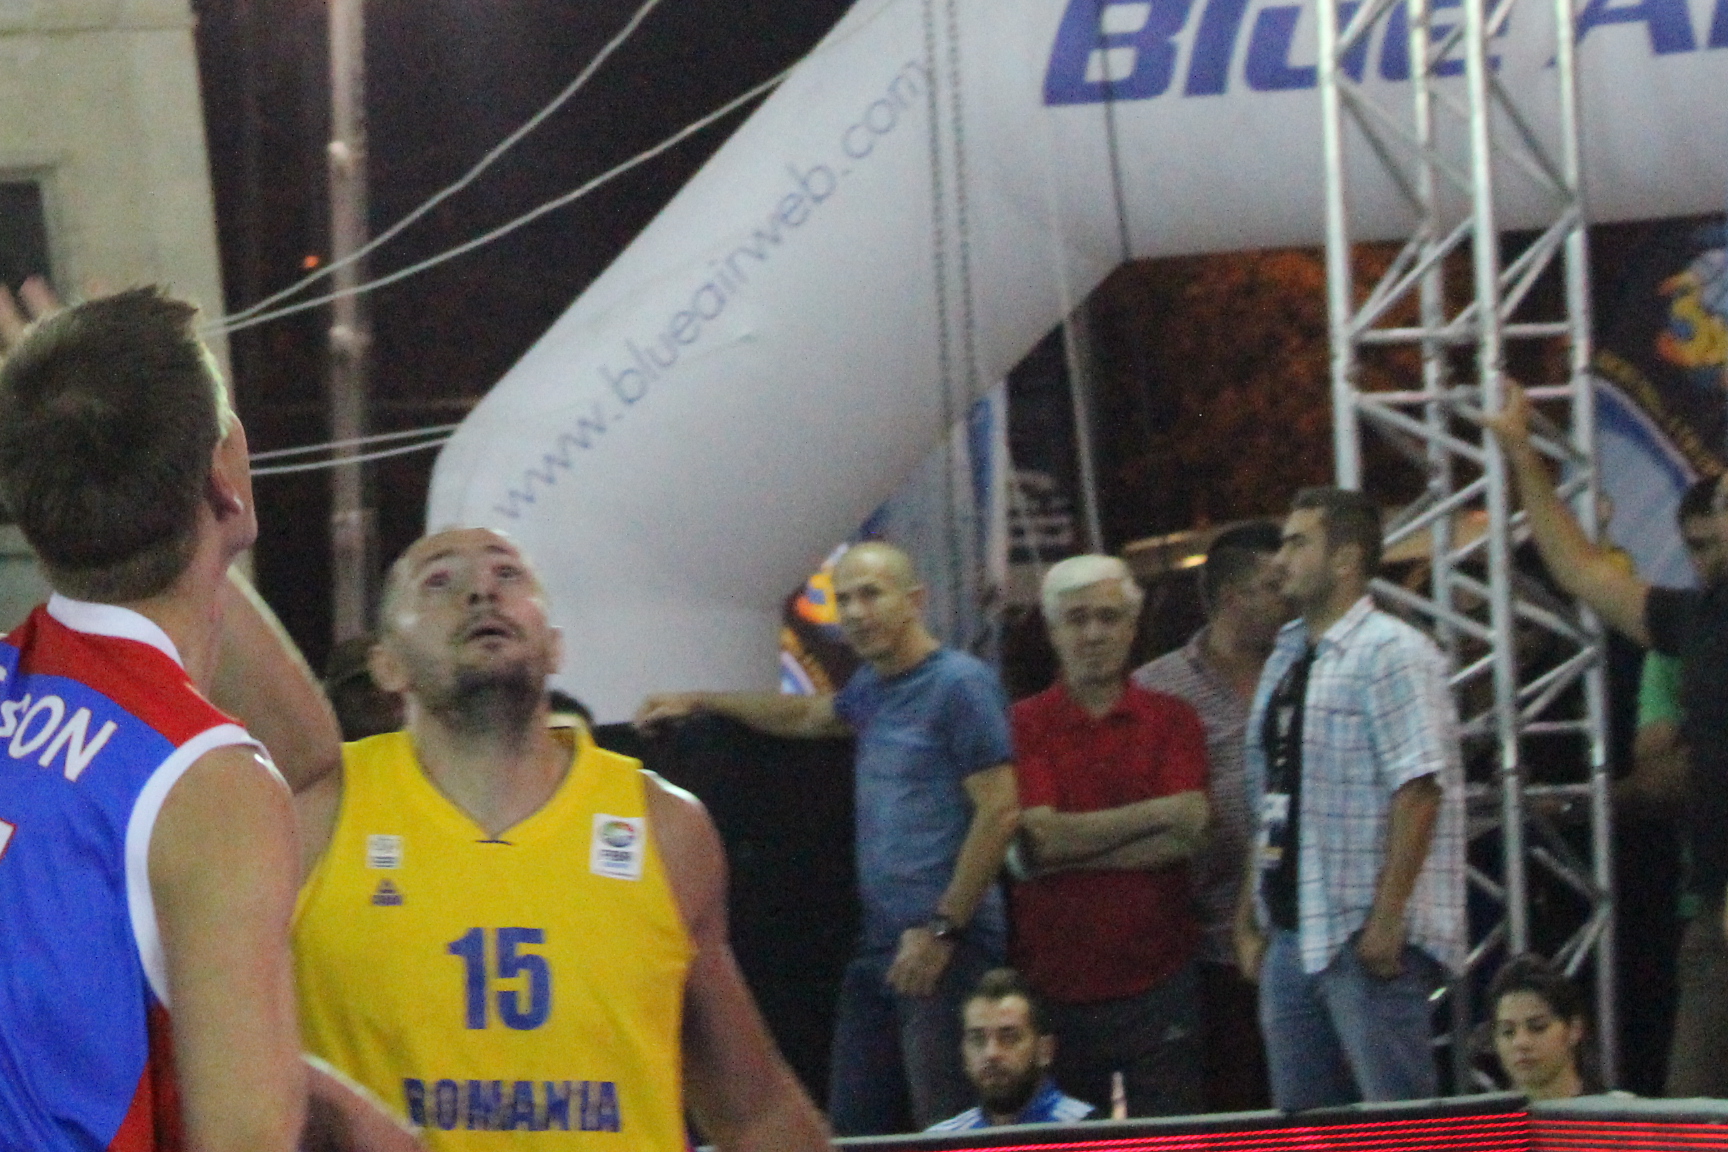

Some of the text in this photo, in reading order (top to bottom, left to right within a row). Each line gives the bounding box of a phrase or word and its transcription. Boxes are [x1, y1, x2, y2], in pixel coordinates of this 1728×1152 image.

[494, 59, 933, 520] www.blueairweb.com
[446, 927, 551, 1030] 15
[403, 1077, 621, 1133] ROMANIA
